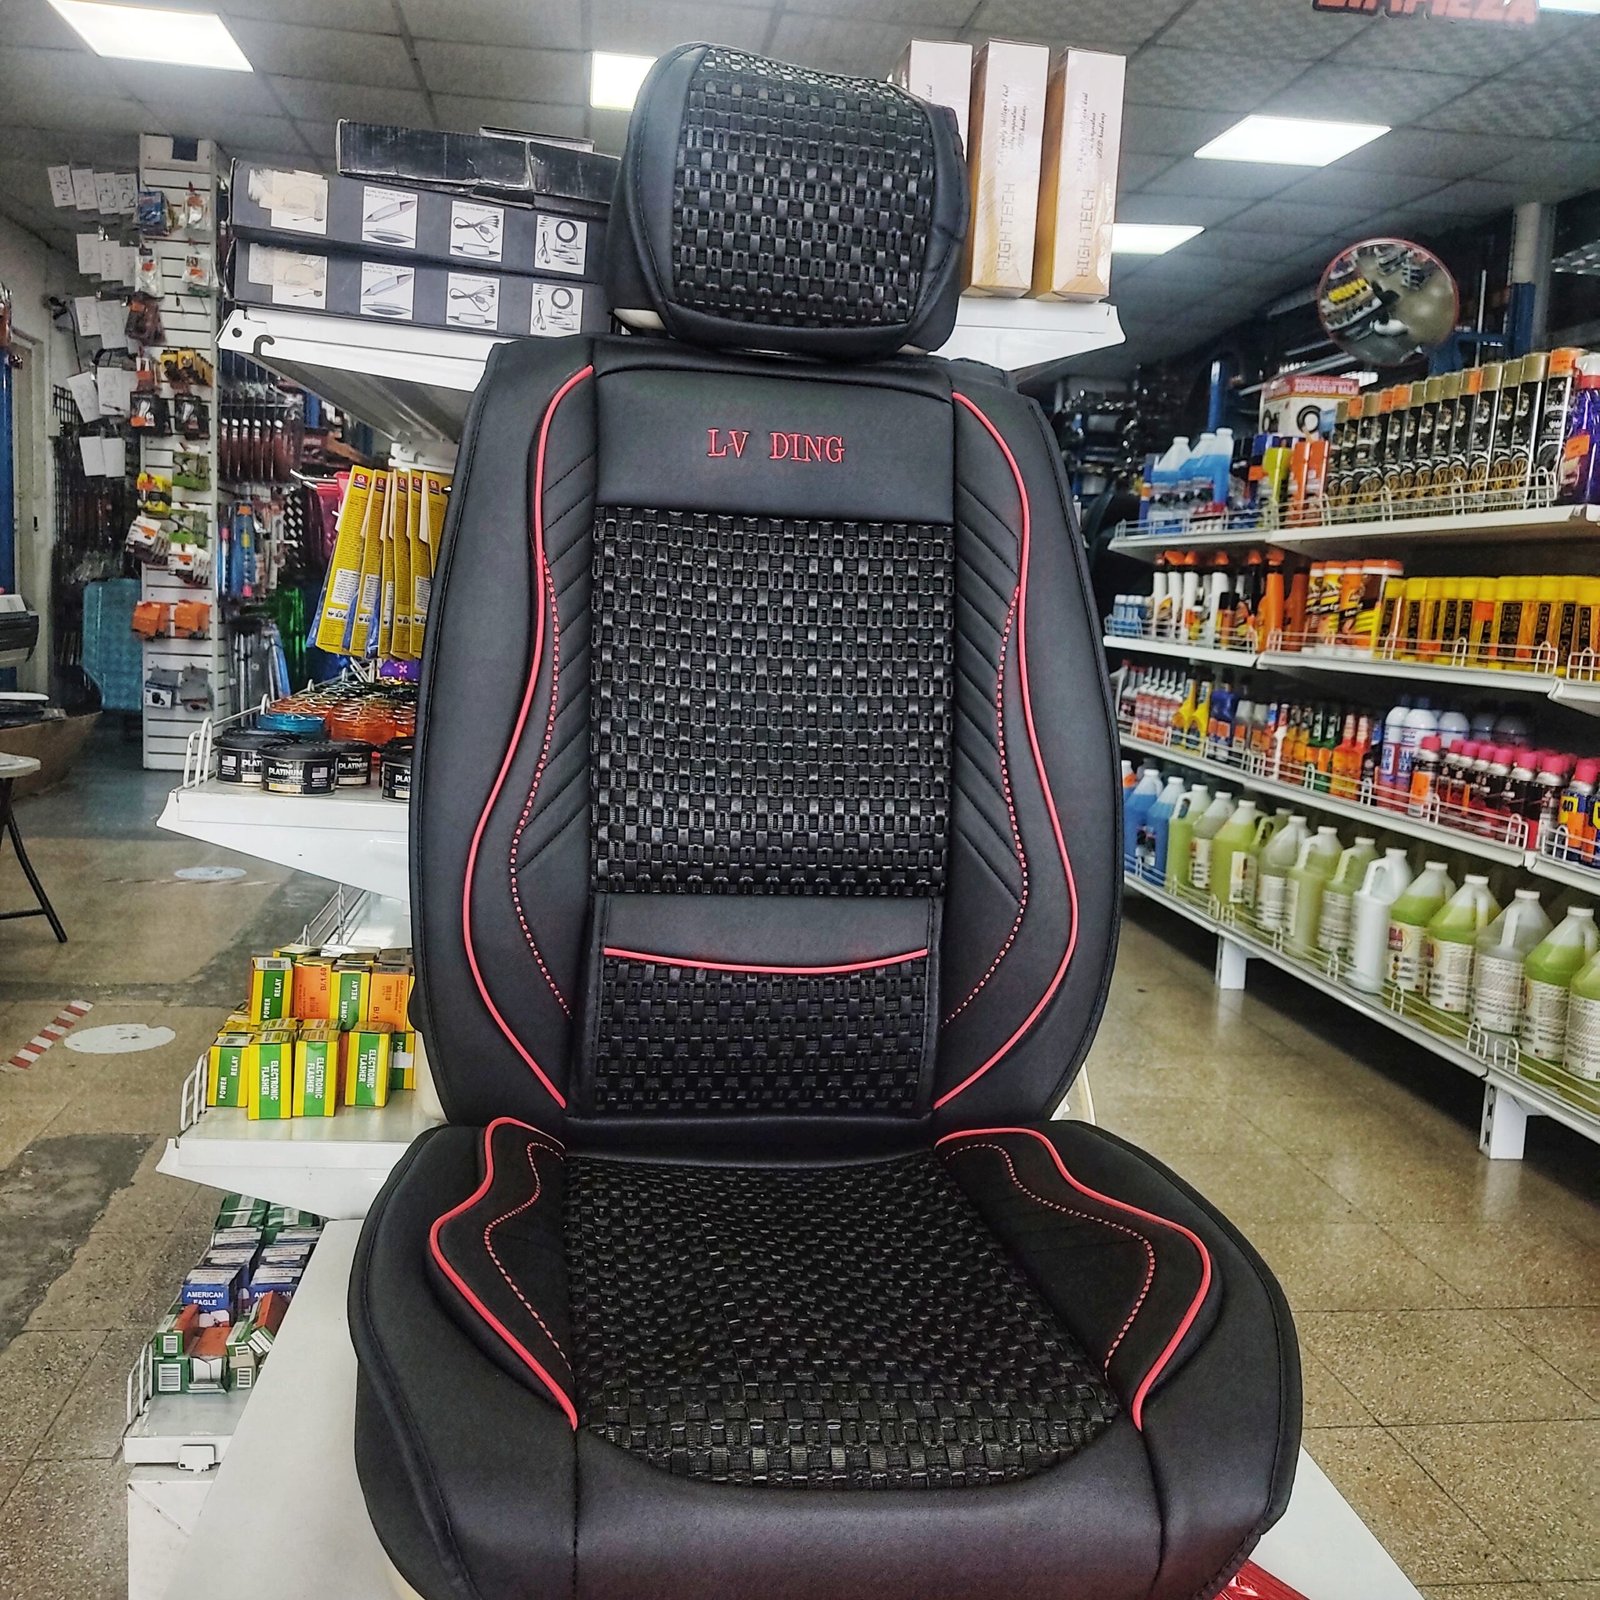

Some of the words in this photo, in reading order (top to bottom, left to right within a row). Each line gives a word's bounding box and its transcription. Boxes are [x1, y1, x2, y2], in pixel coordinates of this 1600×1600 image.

[1000, 183, 1015, 226] TECH
[1079, 189, 1094, 232] TECH
[996, 231, 1012, 271] HIGH
[1076, 238, 1091, 278] HIGH
[707, 428, 750, 459] LV
[769, 431, 846, 464] DING
[268, 767, 303, 777] PLATINUM
[274, 978, 282, 998] RELAY
[351, 980, 359, 1001] RELAY
[263, 998, 271, 1019] POWER
[230, 1055, 239, 1077] RELAY
[261, 1066, 270, 1095] FLASHER
[270, 1060, 279, 1101] ELECTRONIC
[306, 1062, 315, 1094] FLASHER
[315, 1057, 325, 1099] ELECTRONIC
[358, 1054, 367, 1083] FLASHER
[367, 1049, 377, 1089] ELECTRONIC
[219, 1076, 227, 1099] POWER
[186, 1291, 224, 1299] AMERICAN
[193, 1299, 217, 1307] EAGLE
